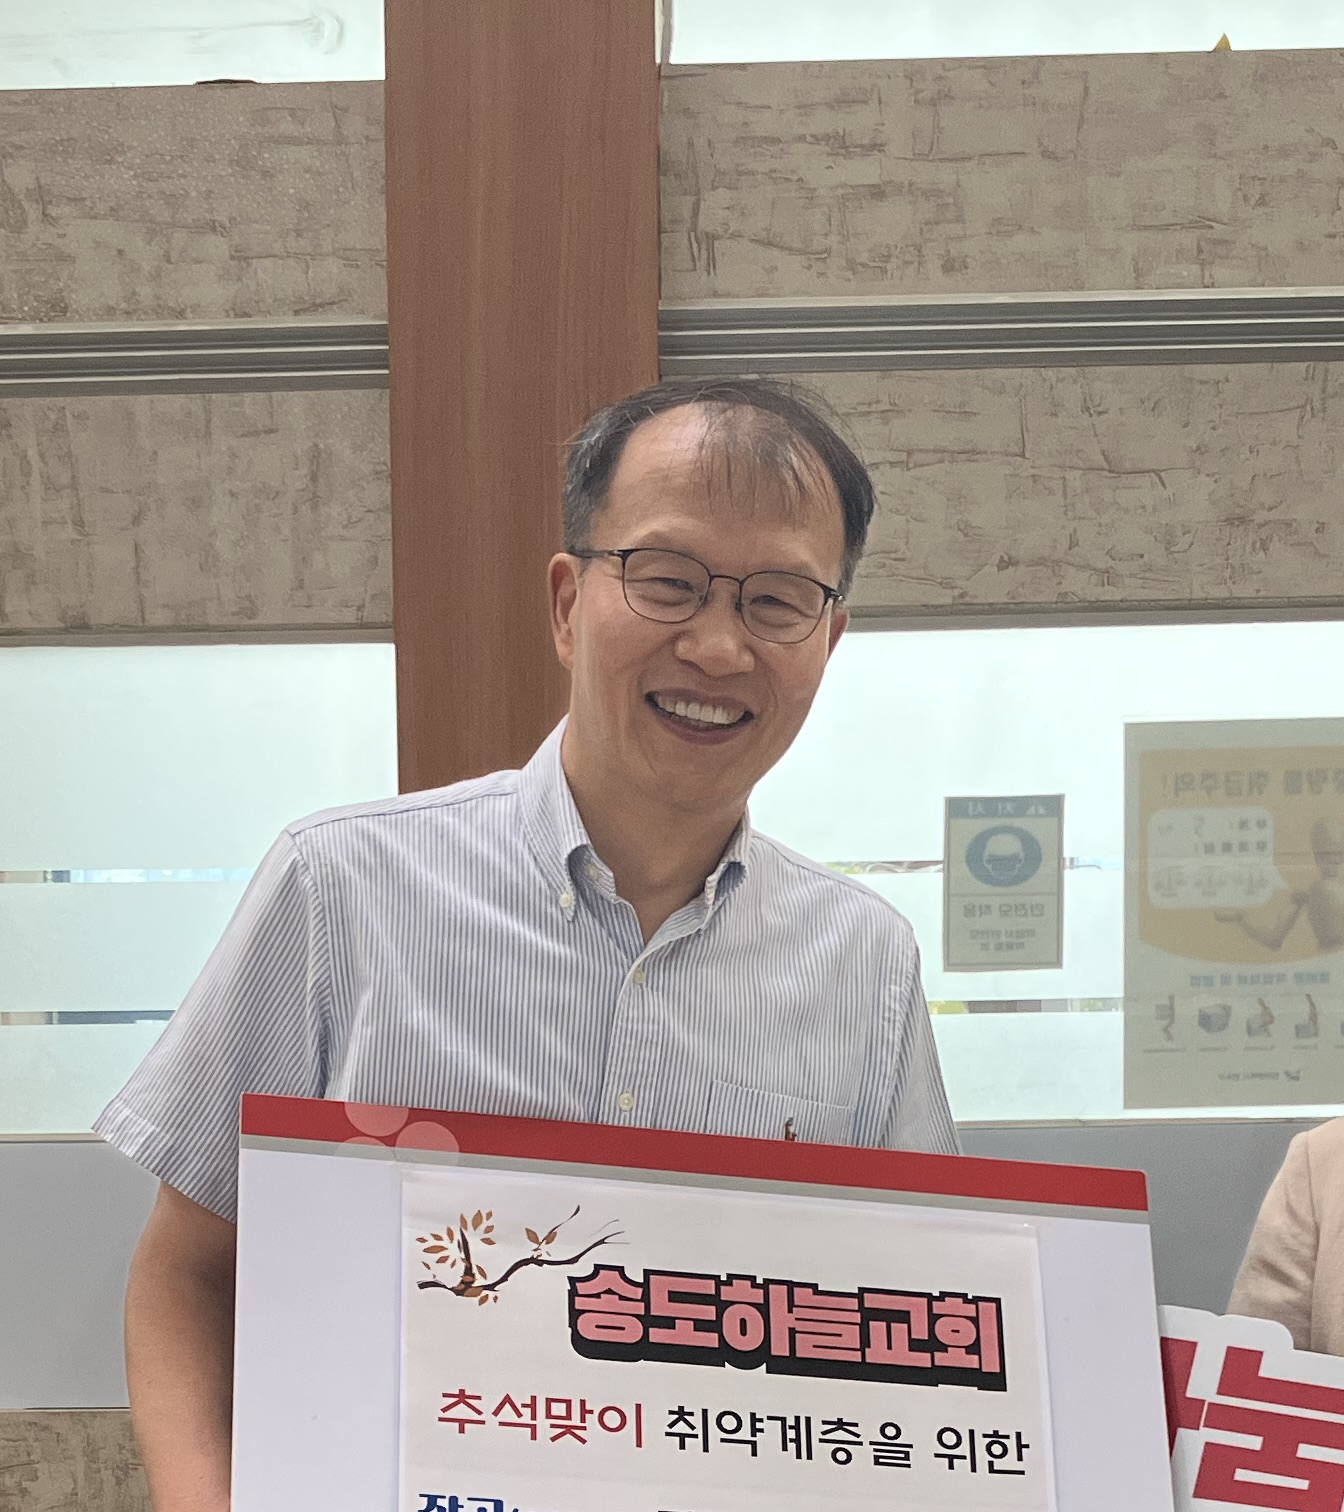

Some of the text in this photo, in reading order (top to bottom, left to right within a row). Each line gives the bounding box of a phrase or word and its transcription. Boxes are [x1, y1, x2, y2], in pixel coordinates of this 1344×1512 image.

[567, 1263, 1008, 1392] 송도하늘교회
[437, 1388, 1031, 1476] 추석맞이 취약계층을 위한
